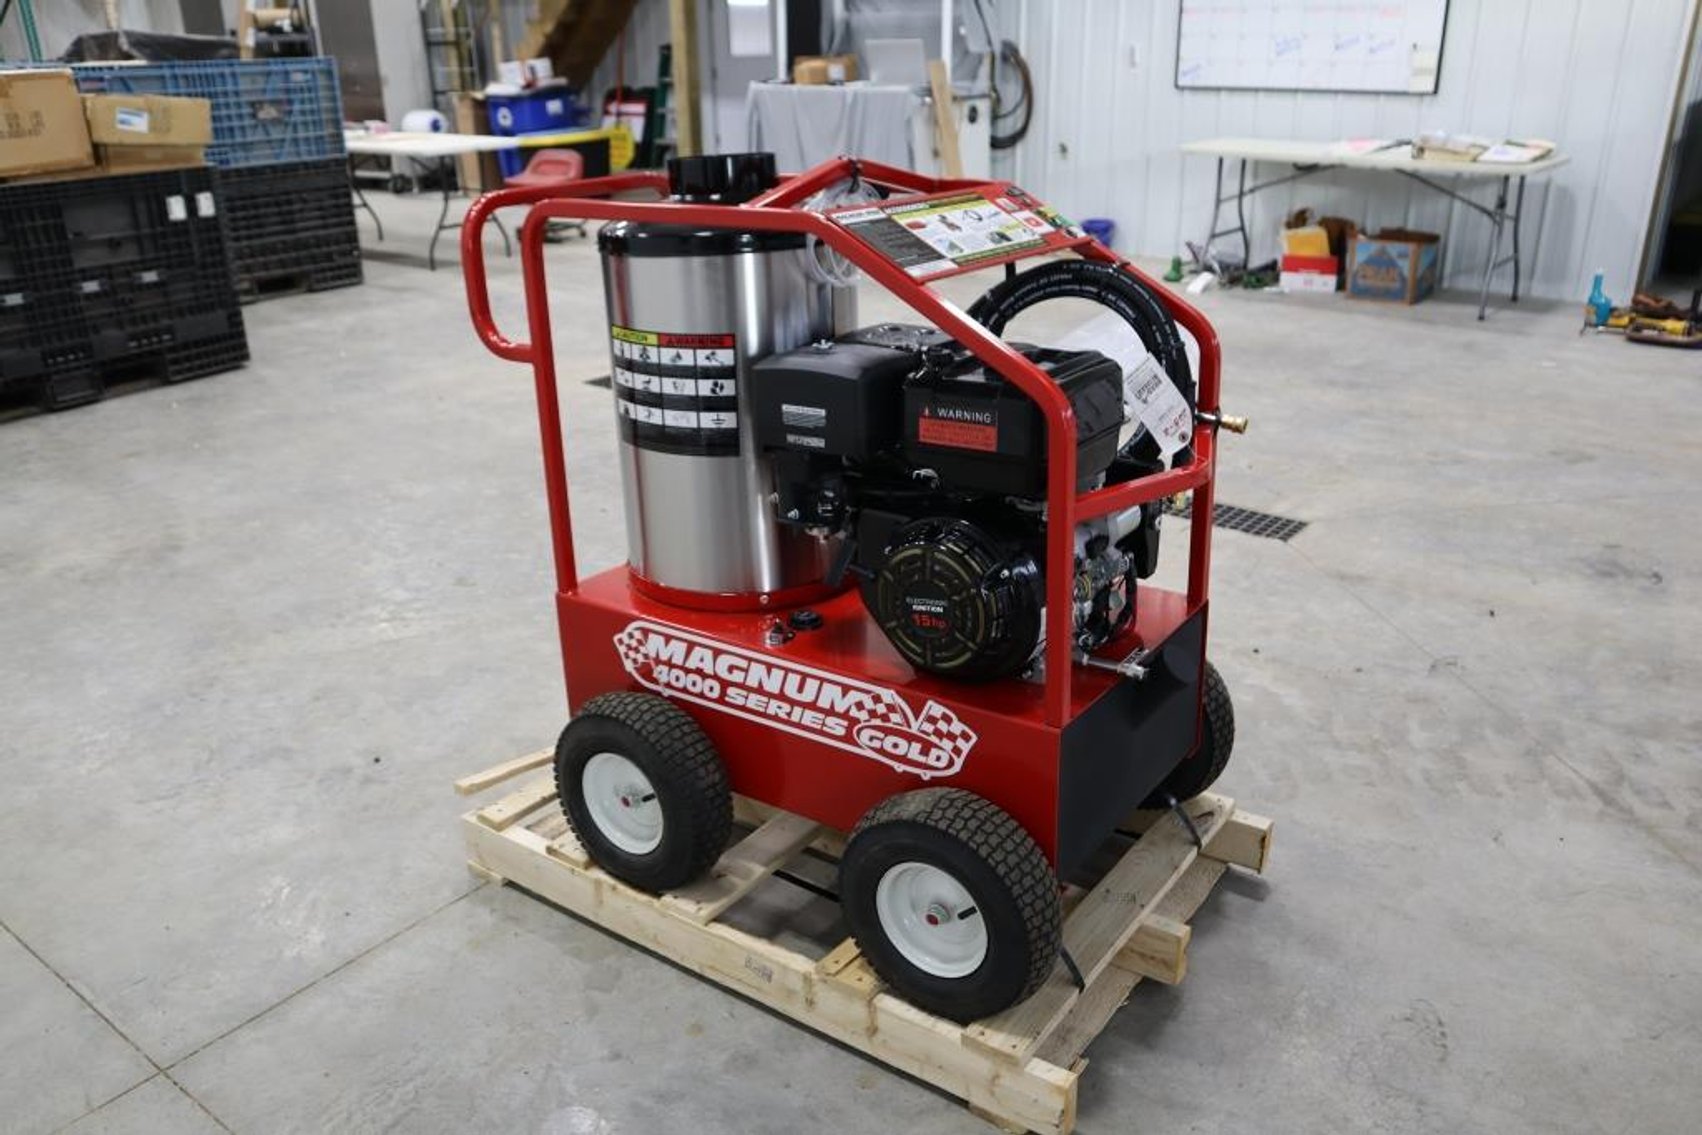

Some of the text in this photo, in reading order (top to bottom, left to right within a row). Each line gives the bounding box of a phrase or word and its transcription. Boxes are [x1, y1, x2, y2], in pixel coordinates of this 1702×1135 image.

[937, 407, 991, 423] WARNING
[912, 605, 944, 613] IGNITION
[646, 633, 860, 713] MAGNUM
[653, 664, 849, 737] 4000 SERIES
[859, 728, 951, 769] GOLD
